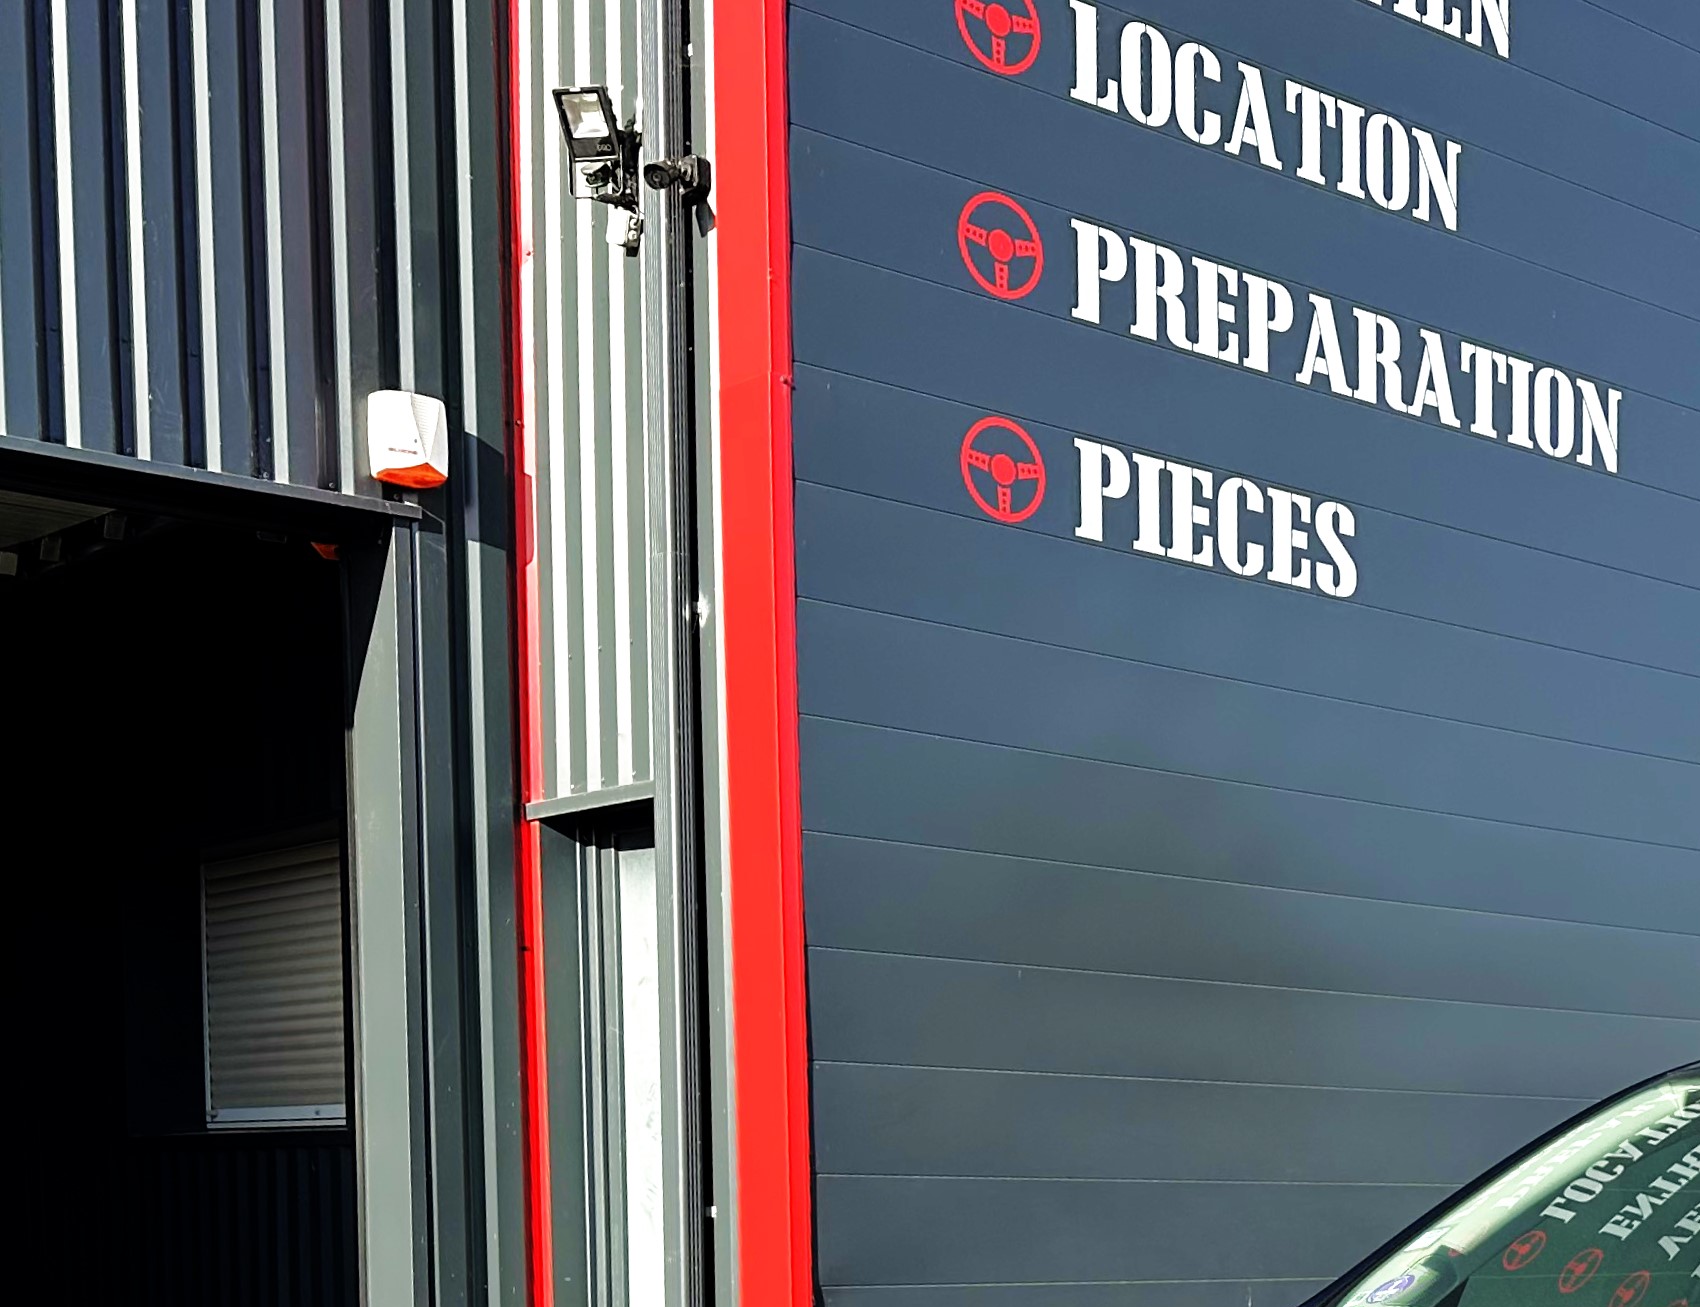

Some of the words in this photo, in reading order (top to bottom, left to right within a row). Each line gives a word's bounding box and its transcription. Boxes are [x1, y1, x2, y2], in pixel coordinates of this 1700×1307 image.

[1069, 0, 1462, 232] LOCATION
[1070, 217, 1623, 474] PREPARATION
[1072, 436, 1359, 600] PIECES
